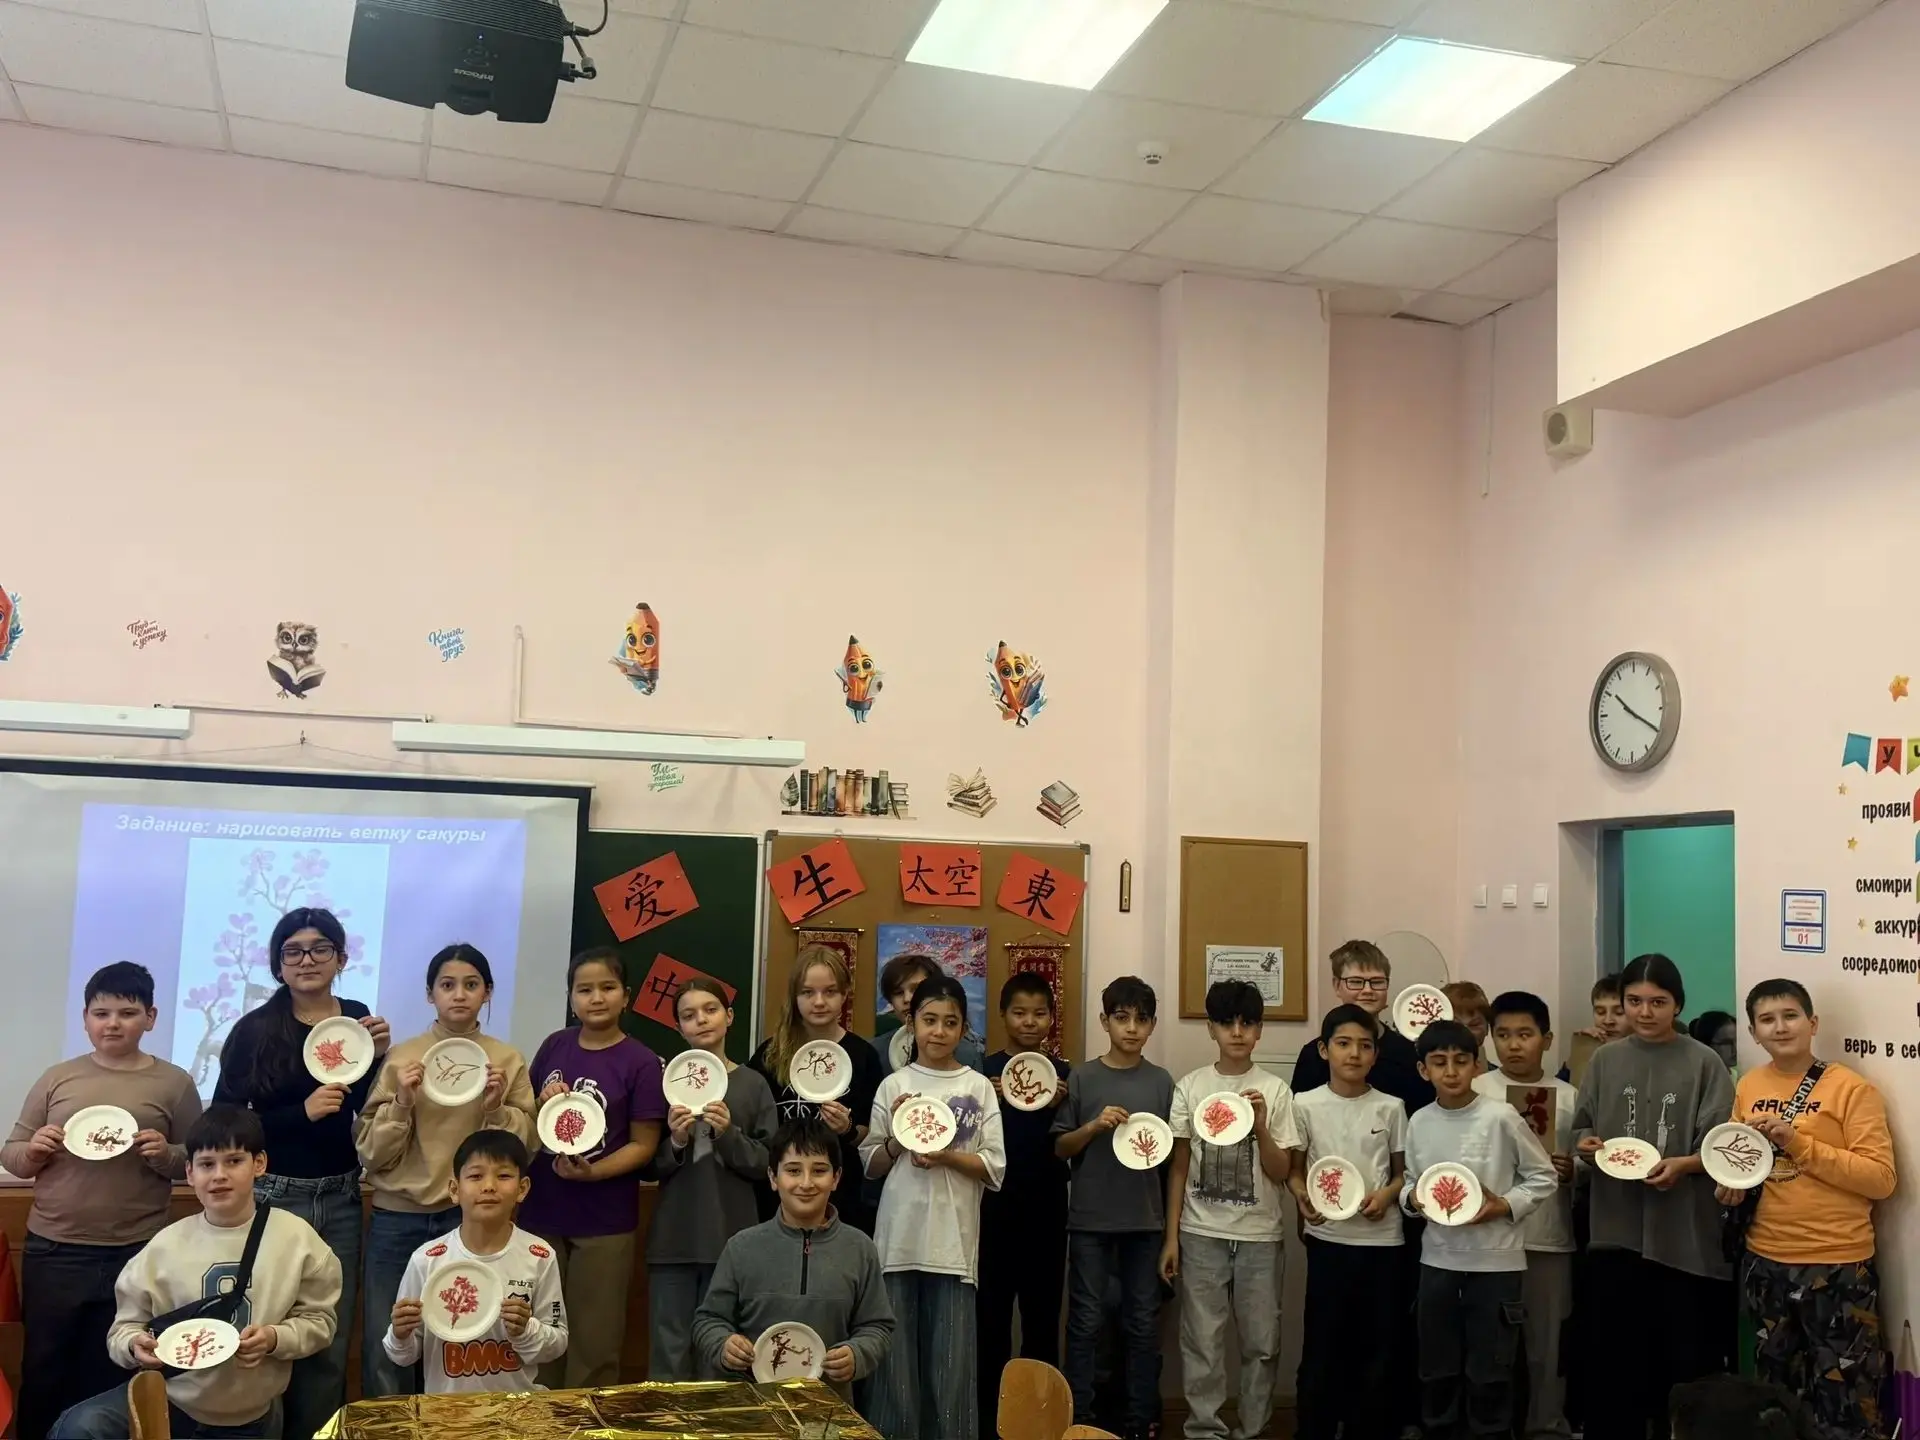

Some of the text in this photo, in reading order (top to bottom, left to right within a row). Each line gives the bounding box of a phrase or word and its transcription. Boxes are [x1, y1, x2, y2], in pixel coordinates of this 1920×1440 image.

[428, 628, 464, 647] Книга
[1862, 801, 1911, 824] прояви
[115, 813, 487, 845] Задание: нарисовать ветку сакуры
[793, 853, 852, 918] 生
[905, 854, 979, 897] 太空
[1856, 878, 1912, 898] смотри
[623, 871, 677, 928] 爱
[1013, 867, 1056, 922] 東
[1797, 933, 1809, 945] 01
[1844, 1037, 1920, 1059] верь в се
[443, 1338, 522, 1378] BMG
